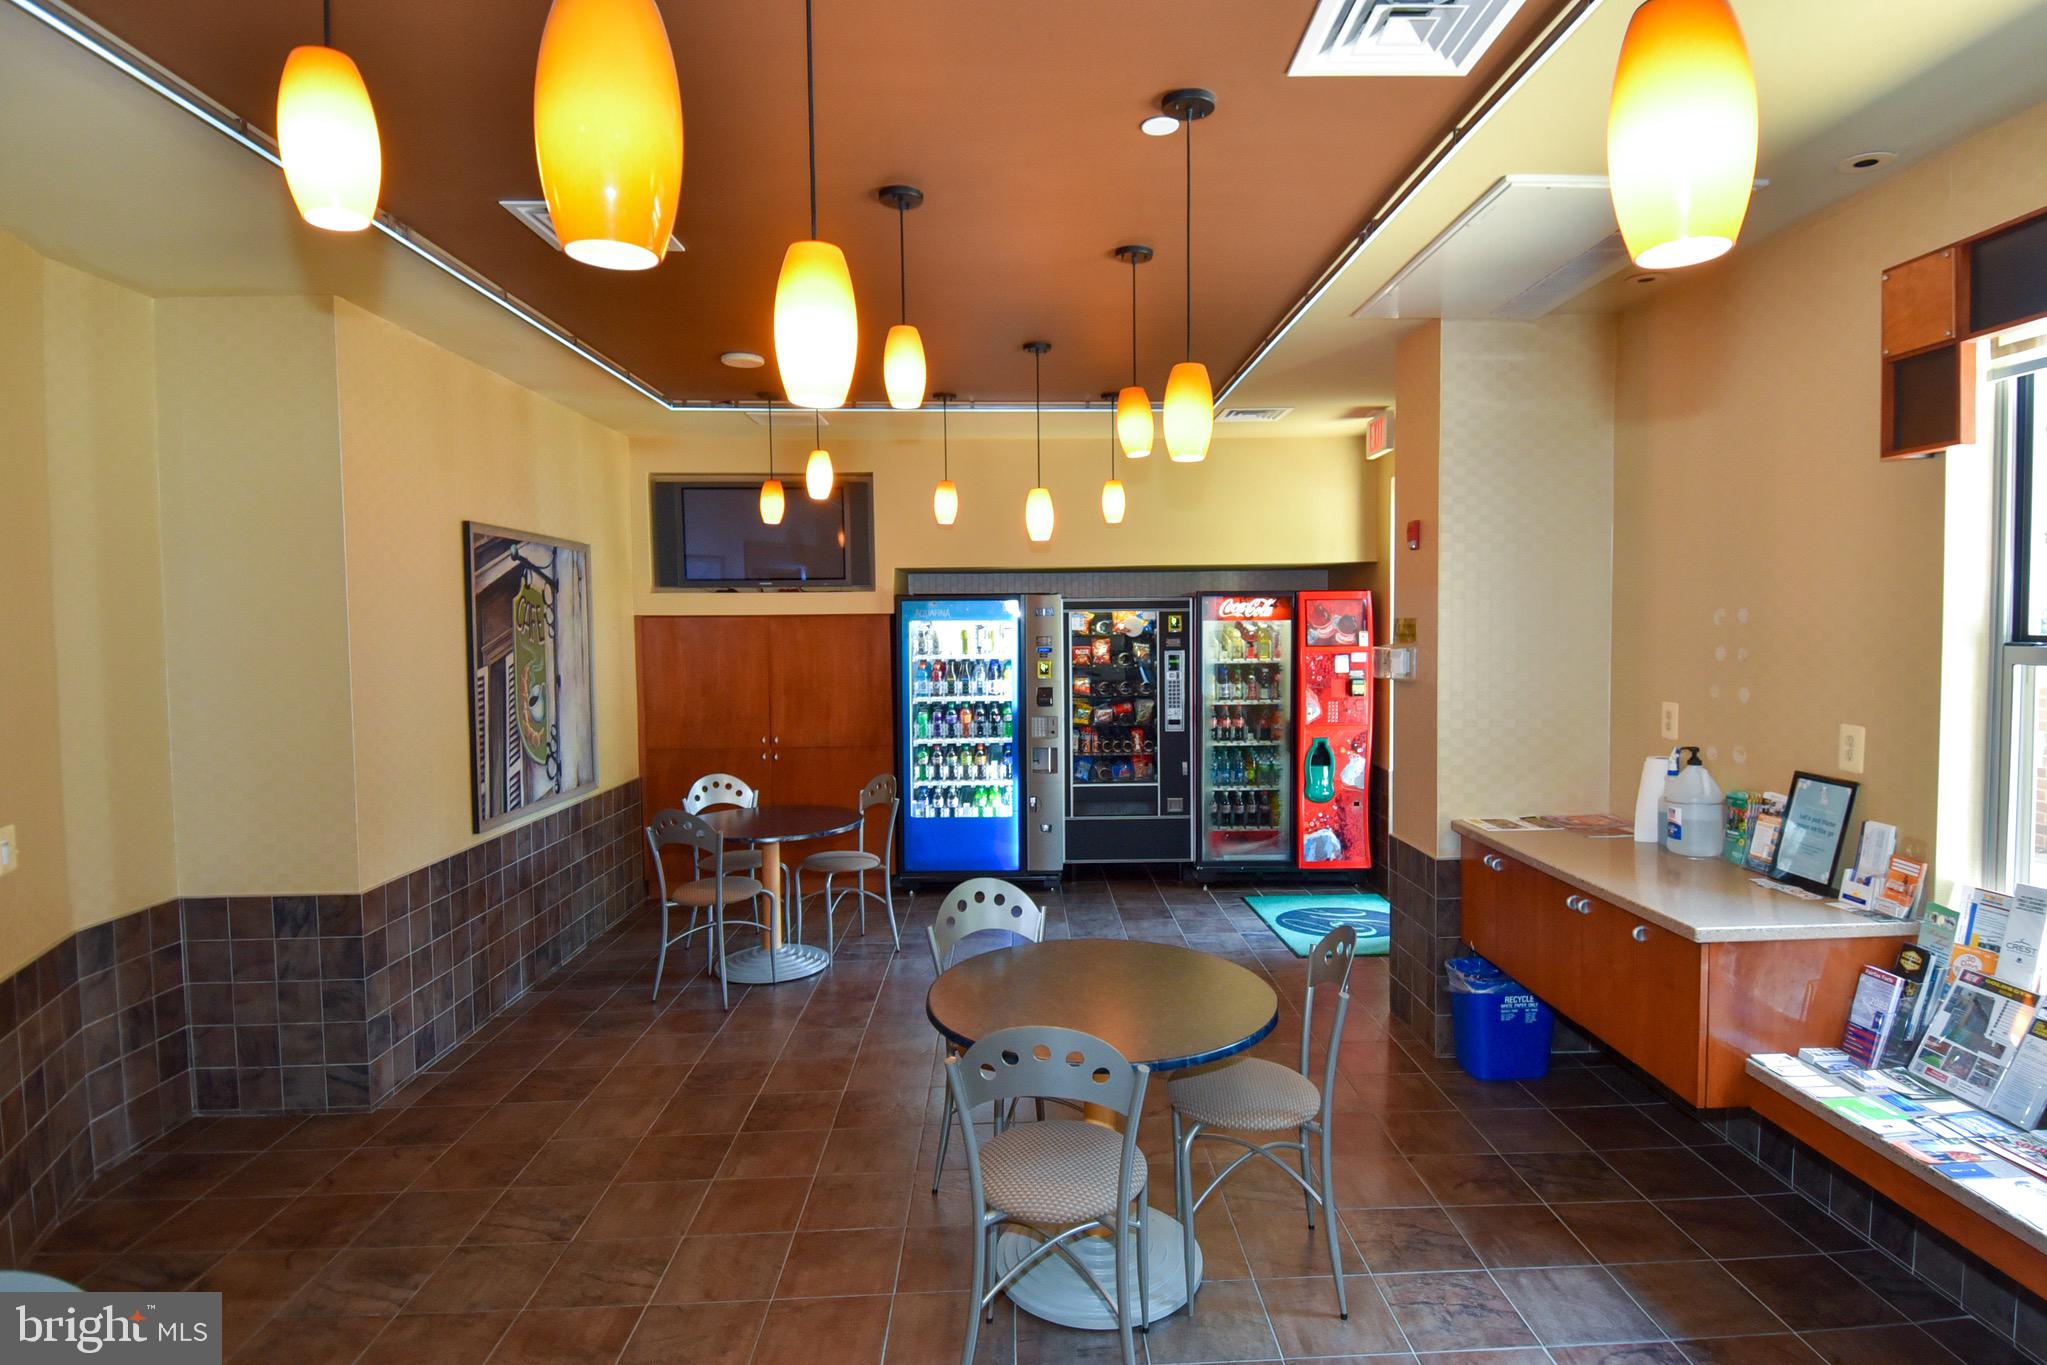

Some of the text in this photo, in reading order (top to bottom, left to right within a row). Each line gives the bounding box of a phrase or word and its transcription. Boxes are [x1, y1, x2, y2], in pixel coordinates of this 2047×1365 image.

[1369, 416, 1385, 452] EXIT
[516, 596, 545, 646] CAFE
[2005, 942, 2038, 957] CREST
[1504, 995, 1534, 1004] RECYCLE
